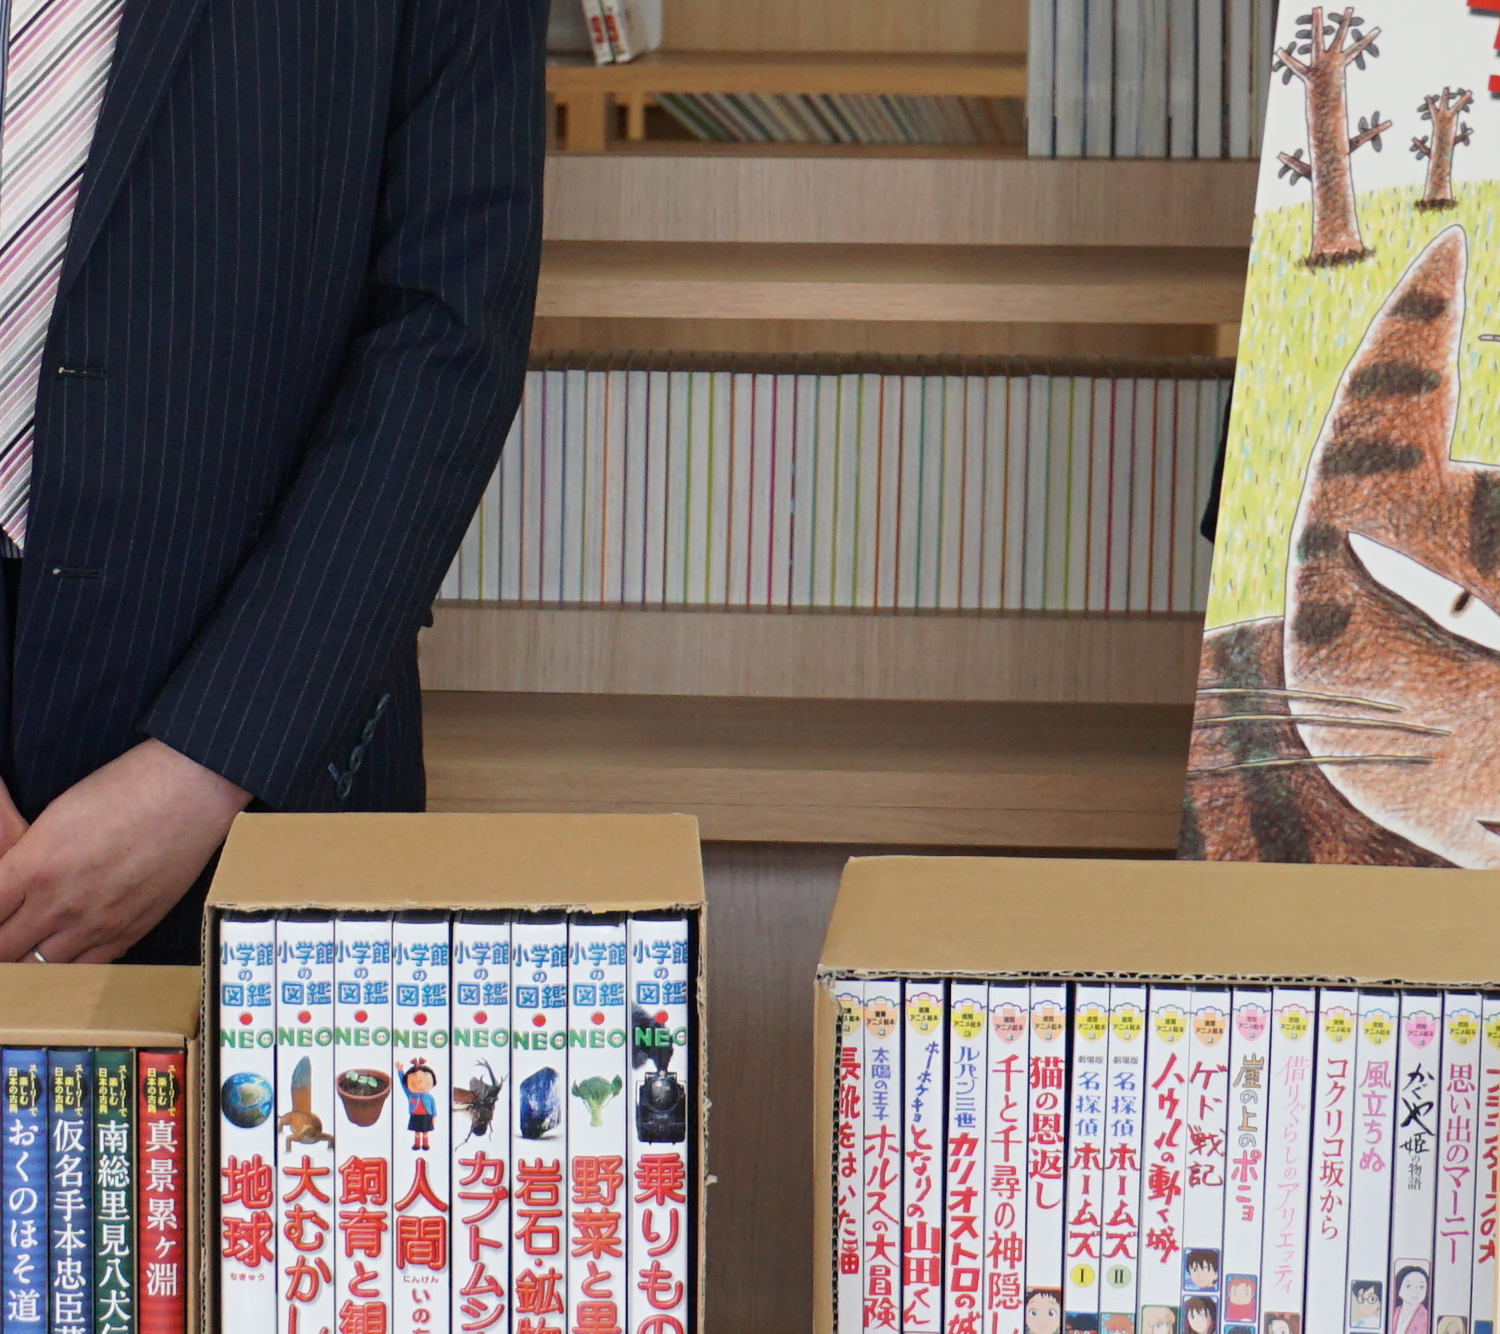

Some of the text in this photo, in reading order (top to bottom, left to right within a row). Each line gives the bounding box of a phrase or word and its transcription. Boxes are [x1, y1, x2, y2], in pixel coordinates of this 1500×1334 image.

[220, 940, 274, 969] 小学館
[394, 940, 449, 969] 小学館
[571, 940, 627, 969] 小学館
[220, 1028, 275, 1050] NEO
[394, 1028, 449, 1050] NEO
[570, 1028, 627, 1050] NEO
[1029, 1054, 1065, 1210] 猫の恩返し
[1145, 1051, 1186, 1267] ハウルの動く城
[1187, 1059, 1229, 1188] ゲド戦記
[1230, 1052, 1266, 1222] 崖の上のポニョ
[1272, 1055, 1310, 1295] 借りぐらしのアリエッティ
[1319, 1057, 1349, 1241] コクリコ坂から
[1358, 1060, 1393, 1173] 風立ちぬ
[1399, 1062, 1436, 1192] かぐや姫の物語
[1440, 1063, 1476, 1265] 思い出のマーニー
[7, 1118, 42, 1324] おくのほそ道
[144, 1118, 179, 1298] 真景累ヶ淵
[221, 1154, 274, 1270] 地球
[395, 1160, 450, 1272] 人間
[863, 1124, 900, 1331] ホルスの大冒険
